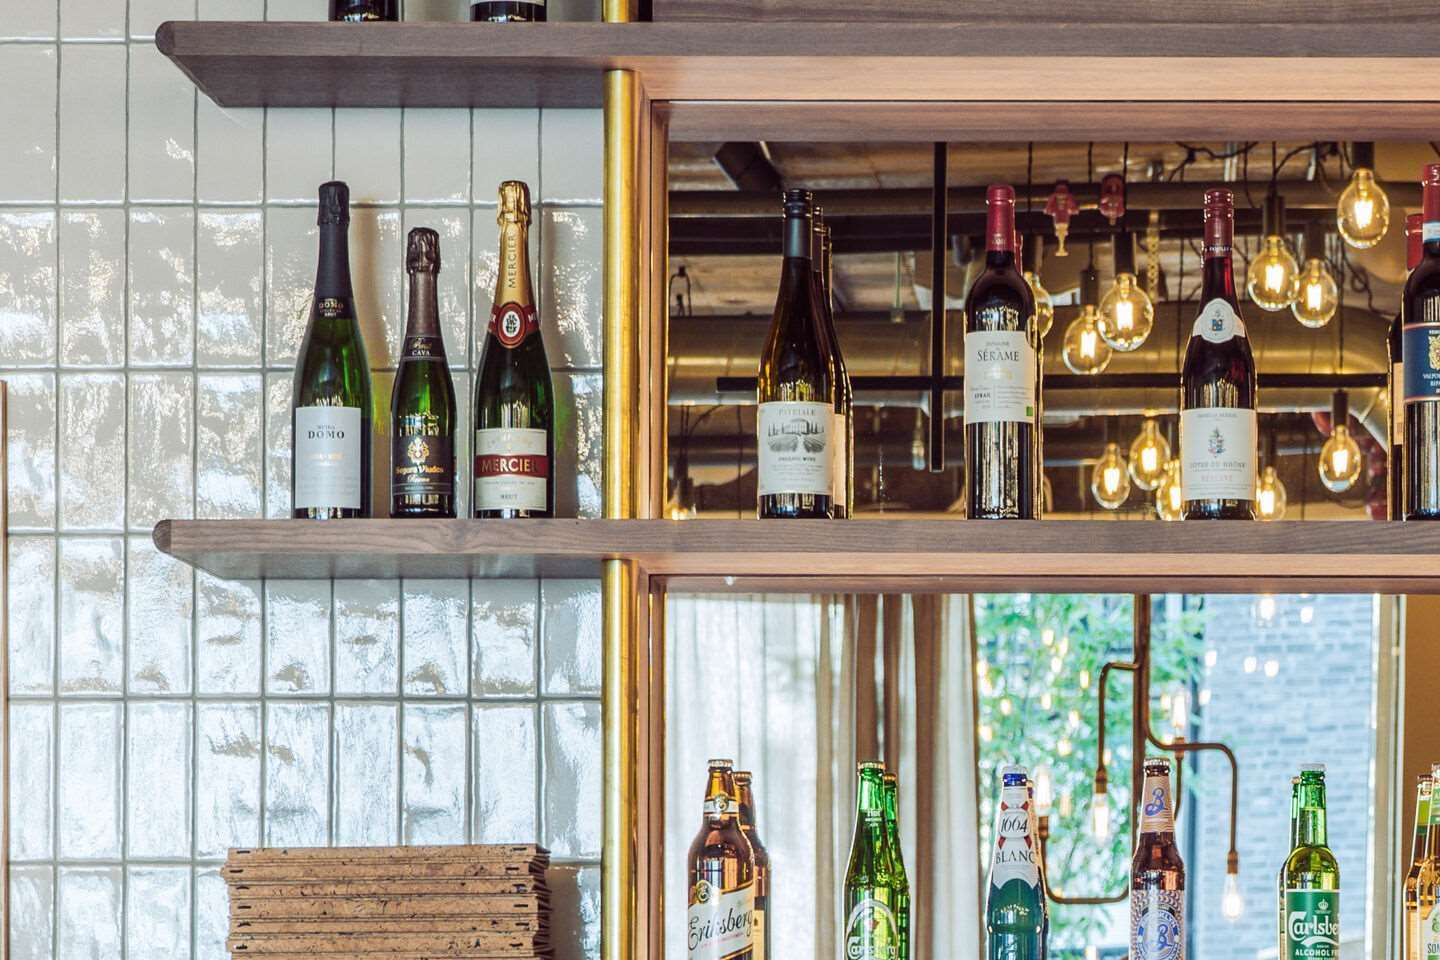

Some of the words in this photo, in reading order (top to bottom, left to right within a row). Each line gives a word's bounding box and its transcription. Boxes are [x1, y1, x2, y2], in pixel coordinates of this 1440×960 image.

[507, 233, 517, 289] MERCIER
[308, 430, 346, 440] DOMO
[995, 850, 1035, 865] BLANC
[688, 907, 753, 951] Eriksberg
[1288, 911, 1339, 941] Carlsbe
[1295, 948, 1331, 957] ALCOHOL
